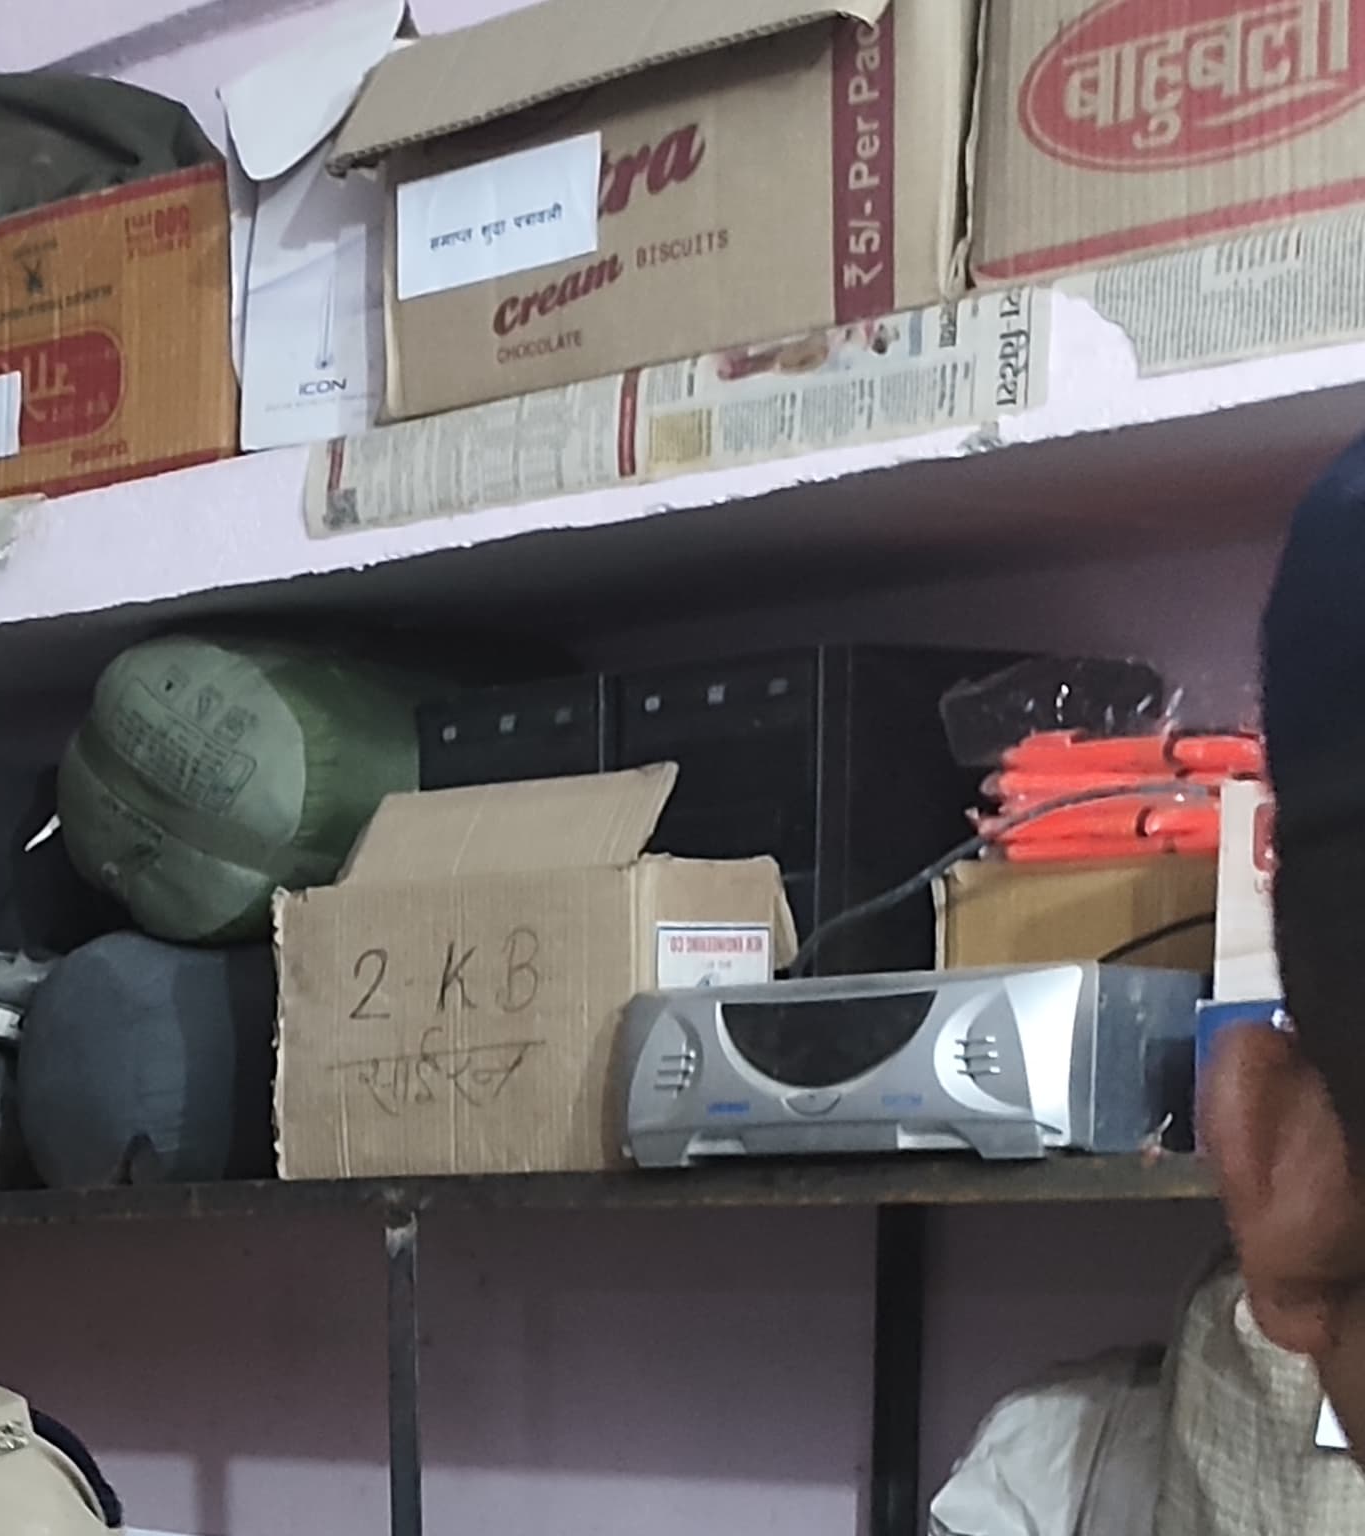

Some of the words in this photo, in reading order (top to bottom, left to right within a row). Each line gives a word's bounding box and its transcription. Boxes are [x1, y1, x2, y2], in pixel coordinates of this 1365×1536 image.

[849, 116, 880, 189] Per
[636, 230, 730, 269] BISCUITS
[496, 330, 583, 365] CHOCOLATE
[298, 377, 348, 394] ICON
